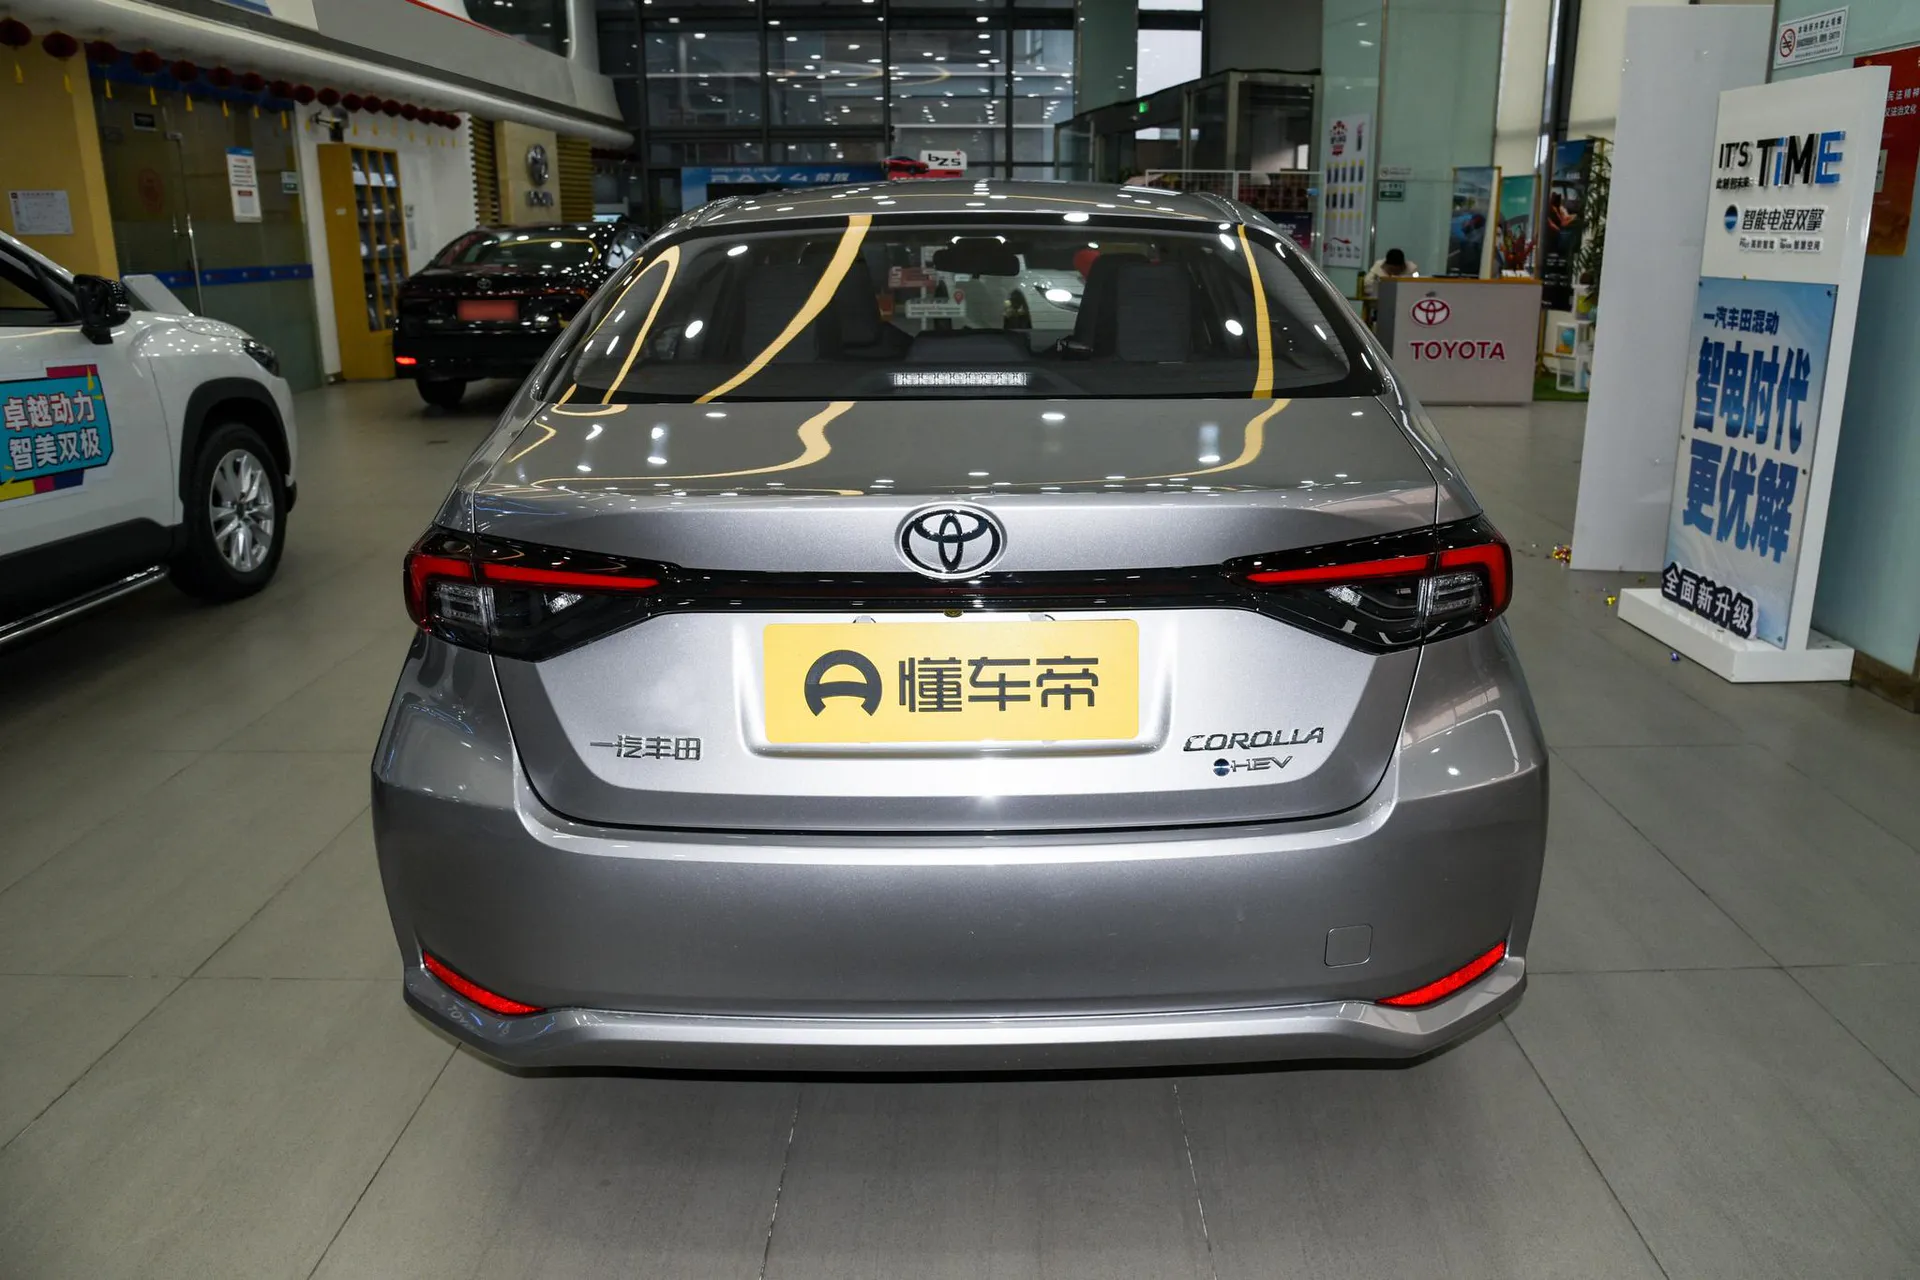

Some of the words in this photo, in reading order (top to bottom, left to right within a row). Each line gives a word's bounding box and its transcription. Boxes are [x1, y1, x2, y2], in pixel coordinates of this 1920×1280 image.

[1718, 141, 1751, 169] IT'S
[1742, 208, 1825, 231] 智能电混双擎
[1703, 305, 1780, 336] 一汽丰田混动
[1410, 341, 1505, 361] TOYOTA
[3, 390, 96, 432] 卓越动力
[1693, 336, 1811, 455] 智电时代
[9, 428, 101, 471] 智美双极
[1682, 438, 1799, 564] 更优解
[1663, 568, 1750, 633] 全面新升级
[898, 655, 1099, 713] 懂车帝
[590, 735, 701, 760] 一汽丰田
[1183, 727, 1325, 752] COROLLA
[1231, 755, 1294, 773] HEV
